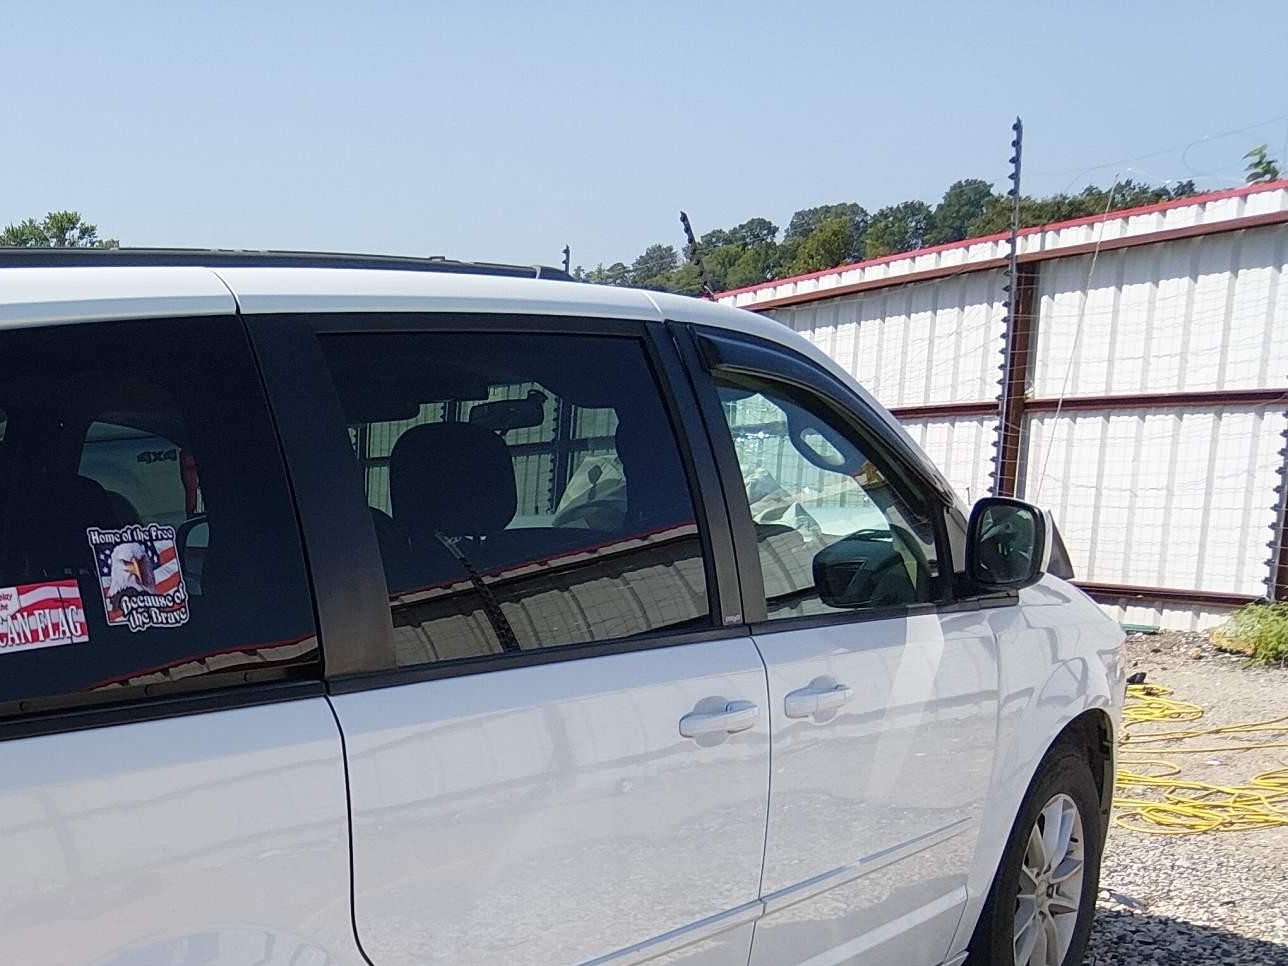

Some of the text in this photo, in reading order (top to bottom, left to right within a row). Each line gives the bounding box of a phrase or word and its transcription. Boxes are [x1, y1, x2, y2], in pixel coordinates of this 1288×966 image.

[90, 526, 174, 545] Home of the Free
[121, 583, 186, 616] Because of
[34, 605, 82, 642] FLAG
[129, 606, 187, 628] the Brave
